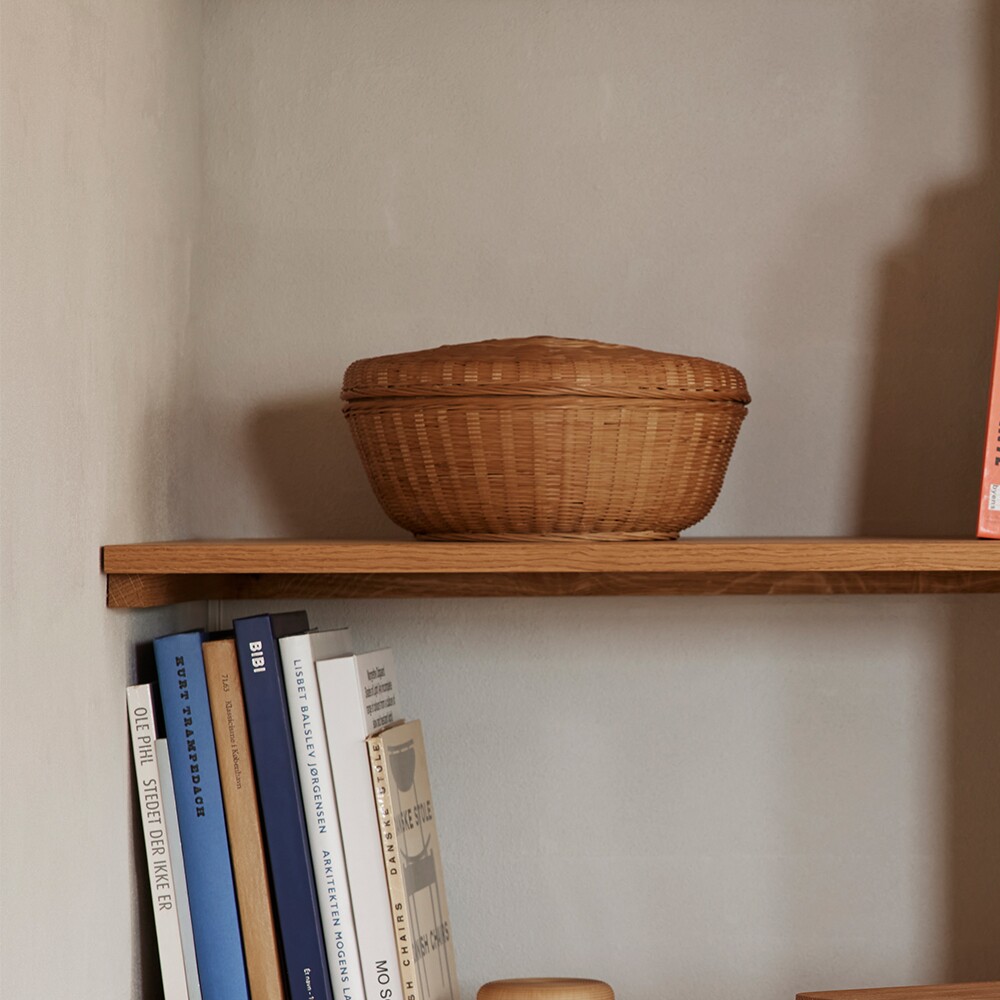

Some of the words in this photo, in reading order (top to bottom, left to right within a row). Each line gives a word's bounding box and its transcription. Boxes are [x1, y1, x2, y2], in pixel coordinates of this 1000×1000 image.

[249, 640, 266, 673] BIBI
[294, 659, 307, 700] LISBET
[134, 707, 149, 730] OLE
[175, 656, 189, 700] KURT
[182, 706, 206, 817] TRAMPEDACH
[300, 706, 316, 758] BALSLEV
[137, 736, 154, 765] PIHL
[225, 701, 236, 743] Klassicisme
[232, 749, 242, 789] København
[143, 779, 162, 823] STEDET
[308, 763, 327, 834] JØRGENSEN
[150, 829, 166, 856] DER
[384, 808, 398, 875] DANSKE
[154, 860, 170, 890] IKKE
[322, 850, 341, 926] ARKITEKTEN
[158, 895, 173, 911] ER
[395, 903, 410, 966] CHAIRS
[335, 931, 349, 983] MOGENS
[376, 961, 390, 985] MO
